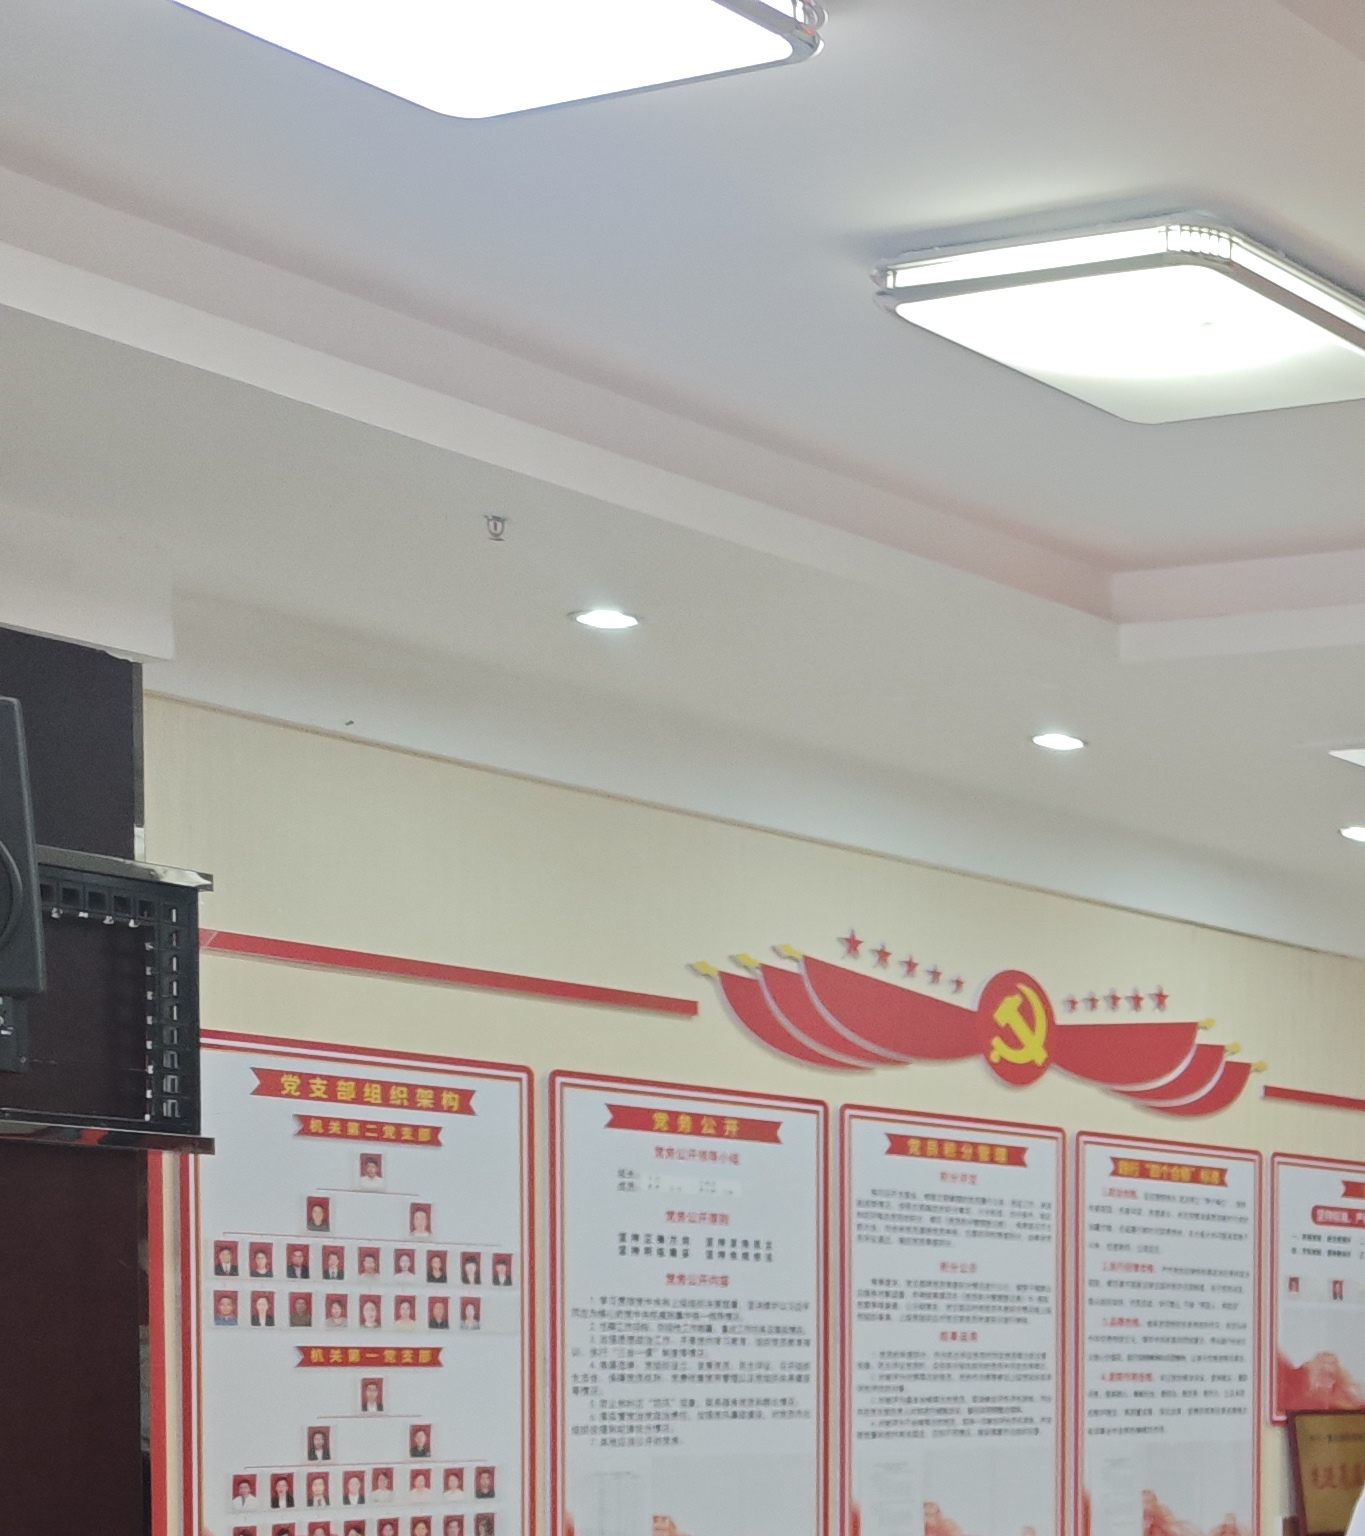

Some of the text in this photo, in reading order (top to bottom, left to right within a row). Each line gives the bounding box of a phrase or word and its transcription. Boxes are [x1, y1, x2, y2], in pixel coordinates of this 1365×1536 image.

[279, 1072, 461, 1112] 党支部组织架构
[309, 1117, 433, 1142] 机关第二党支部
[652, 1111, 740, 1137] 党务公开
[906, 1137, 1010, 1164] 党员积分管理
[310, 1348, 433, 1364] 机关第一党支部
